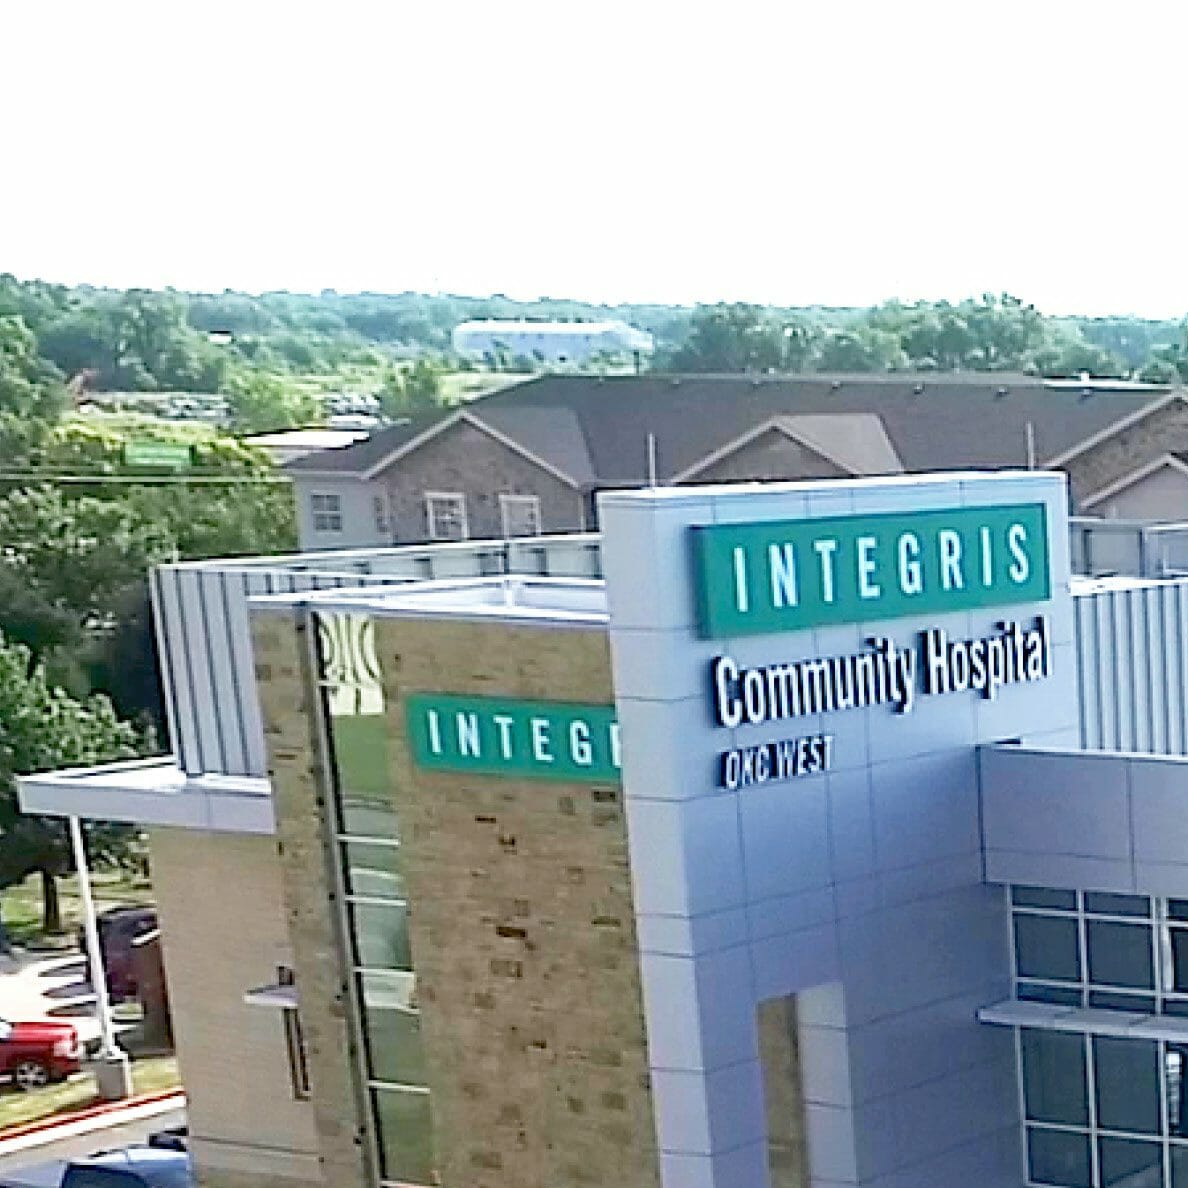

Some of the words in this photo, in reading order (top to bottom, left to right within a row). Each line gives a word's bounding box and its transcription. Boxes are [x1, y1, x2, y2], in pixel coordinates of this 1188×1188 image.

[733, 523, 1030, 613] INTEGRIS
[716, 637, 916, 728] Community
[924, 614, 1050, 701] Hospital
[724, 744, 770, 791] OKC
[776, 735, 834, 779] WEST
